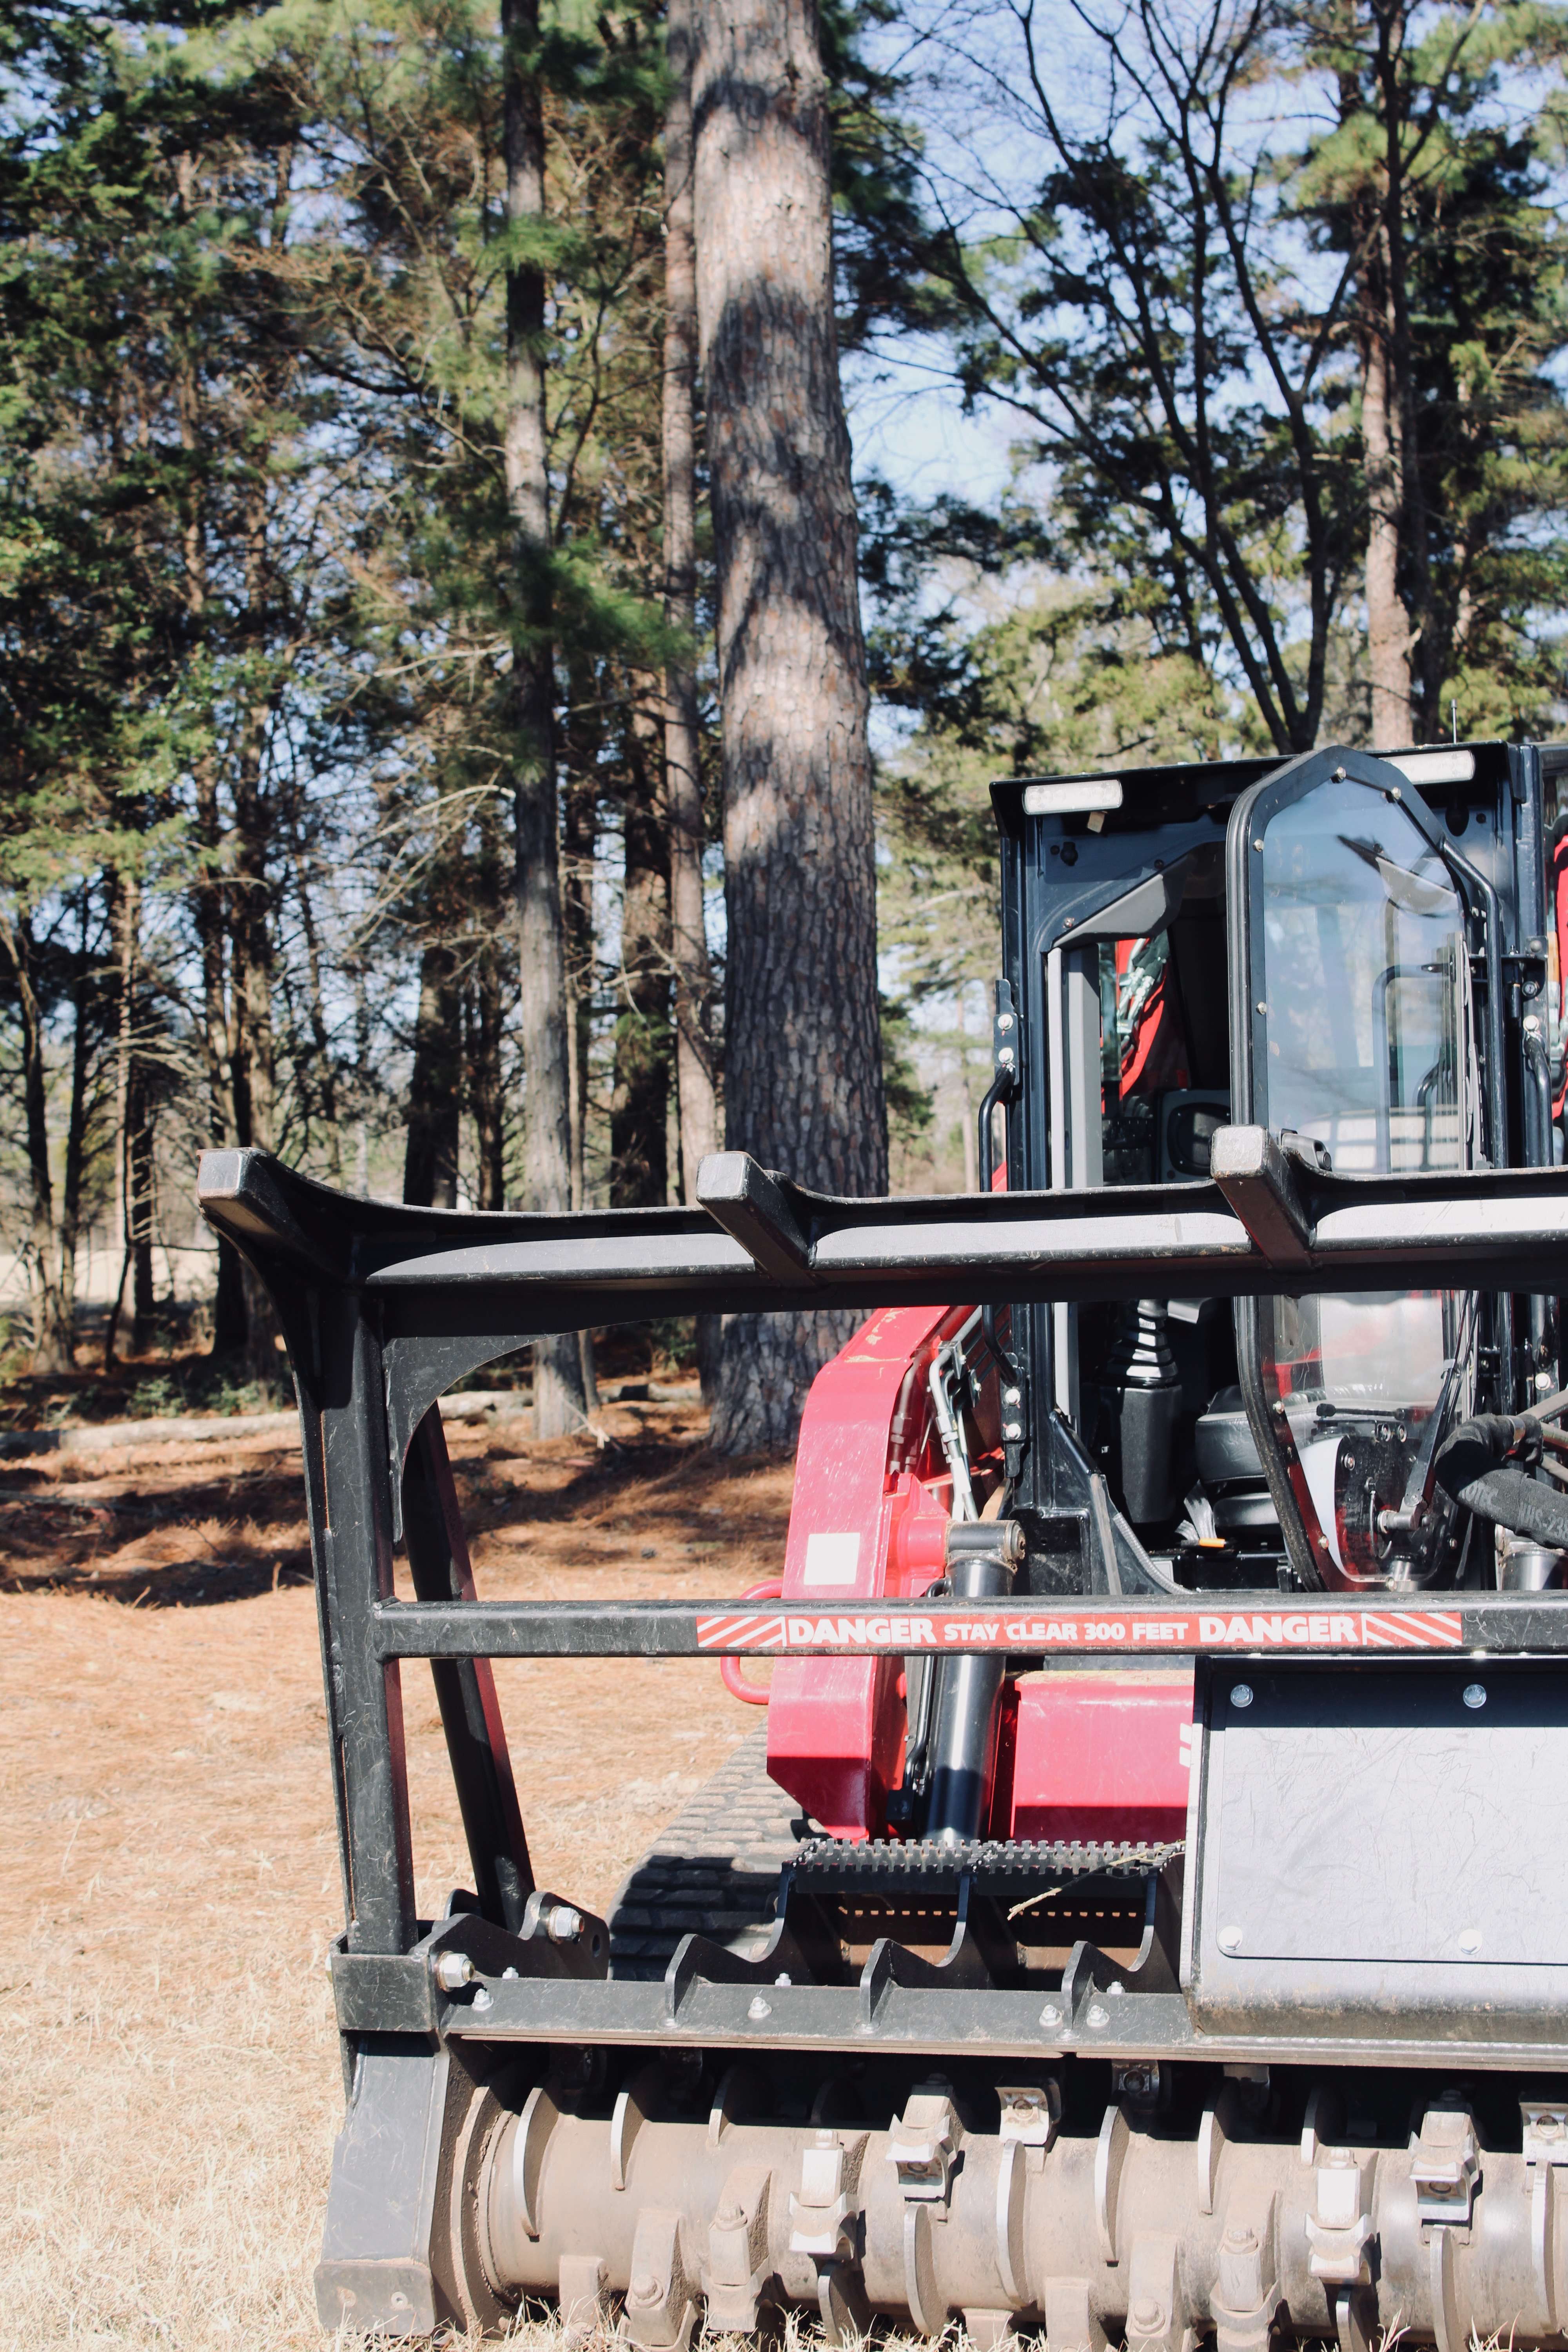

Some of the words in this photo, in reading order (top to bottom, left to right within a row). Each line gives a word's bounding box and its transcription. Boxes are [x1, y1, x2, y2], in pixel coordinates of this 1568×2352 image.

[788, 1618, 937, 1644] DANGER
[944, 1623, 1000, 1641] STAY
[1006, 1623, 1078, 1641] CLEAR
[1084, 1622, 1126, 1641] 300
[1132, 1622, 1189, 1640] FEET
[1199, 1616, 1359, 1642] DANGER
